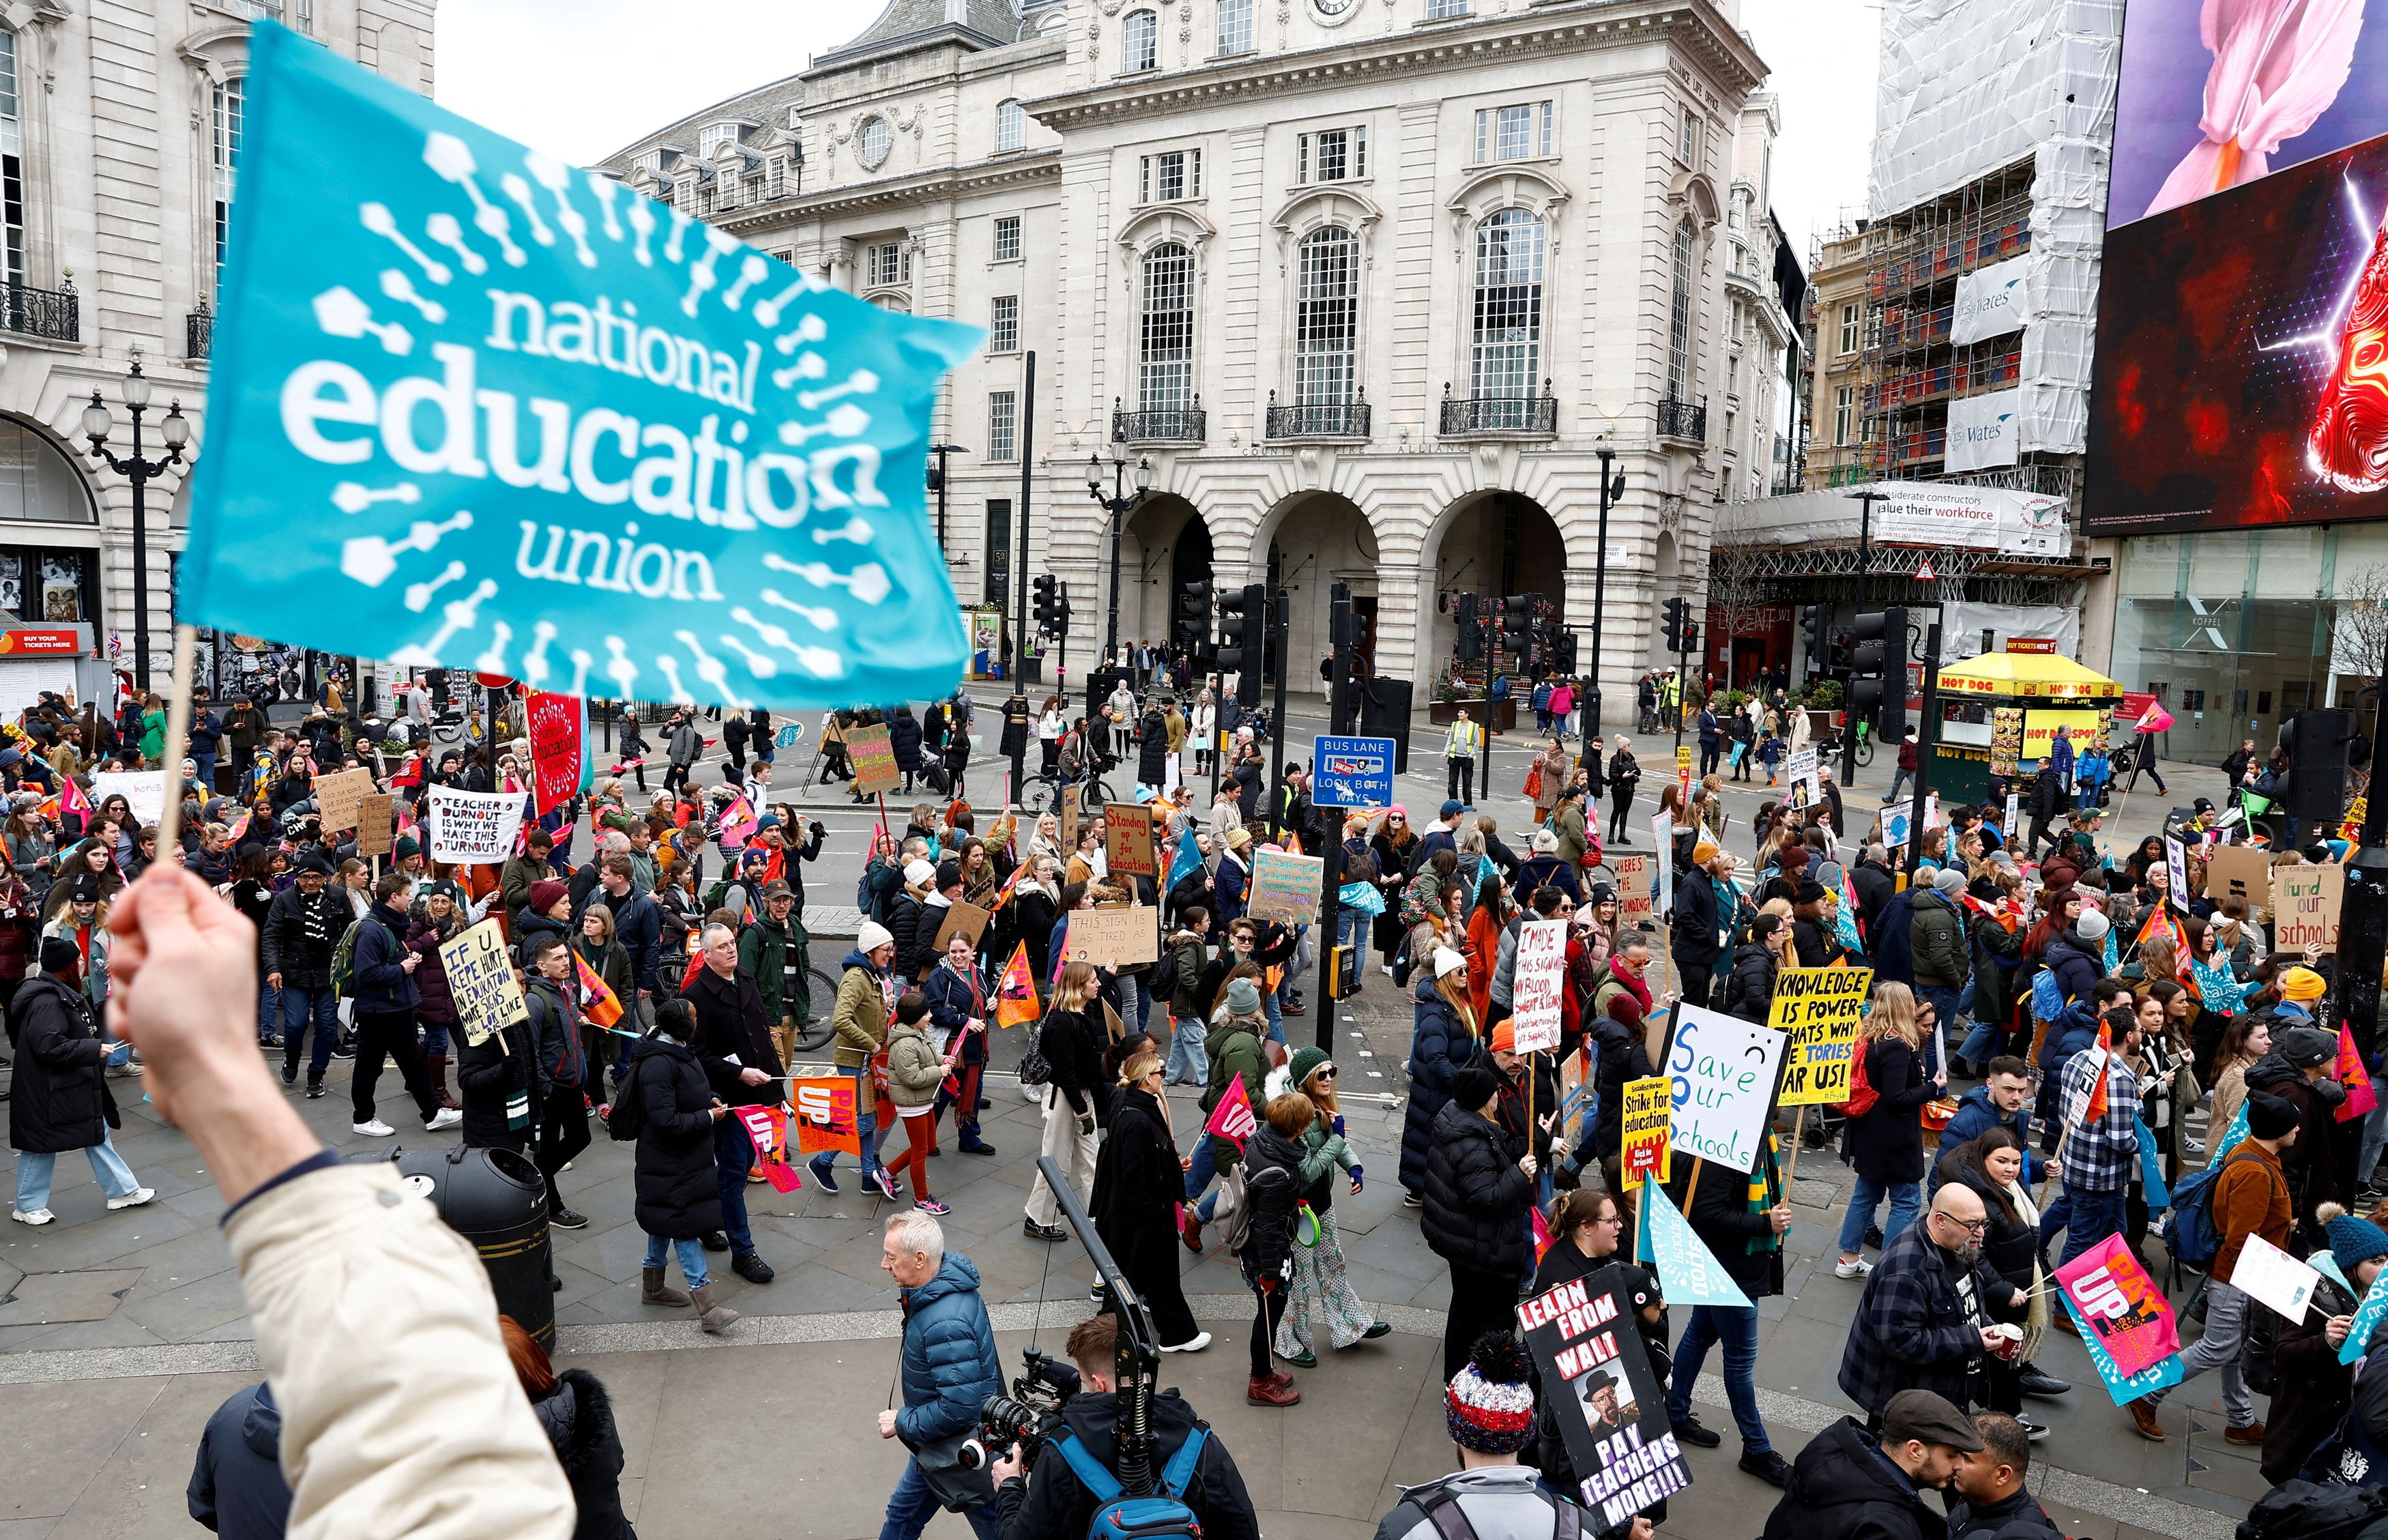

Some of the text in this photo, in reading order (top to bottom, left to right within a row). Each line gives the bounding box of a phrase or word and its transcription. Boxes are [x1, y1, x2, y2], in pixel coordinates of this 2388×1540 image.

[1977, 291, 2009, 314] Wates
[485, 289, 762, 413] national
[280, 341, 890, 530] education
[1967, 425, 2000, 442] Wates
[1242, 447, 1296, 456] COUNTY
[1398, 444, 1474, 452] ALLIANCE
[1517, 443, 1552, 451] LIFE
[1927, 494, 1981, 505] constructors
[1906, 504, 1993, 520] their workforce
[516, 520, 724, 602] union
[995, 552, 1005, 562] 52
[1779, 609, 1790, 622] W1
[2192, 618, 2222, 626] KOPPEL
[1942, 678, 1994, 692] HOT DOG
[2050, 684, 2091, 695] HOT DOG
[2026, 729, 2047, 739] HOT
[1324, 741, 1384, 753] BUS LANE
[1936, 747, 1990, 762] HOT DOG
[854, 754, 894, 768] Education
[1319, 779, 1351, 788] LOOK
[1356, 780, 1387, 790] BOTH
[443, 798, 501, 811] TEACHER
[1066, 794, 1075, 807] Invest
[1336, 793, 1369, 802] WAYS
[442, 808, 501, 822] BURNOUT
[1106, 809, 1146, 837] Standing
[442, 819, 499, 830] IS WHY WE
[442, 829, 497, 841] HAVE THIS
[1121, 831, 1130, 843] up
[443, 840, 499, 854] TURNOUT!
[1119, 843, 1133, 856] for
[1109, 856, 1151, 872] education
[1257, 854, 1296, 869] I teach
[1614, 857, 1642, 874] WHERE'S
[1261, 869, 1268, 877] to
[1271, 870, 1290, 881] stand
[1616, 877, 1631, 892] THE
[2284, 875, 2321, 897] Fund
[1263, 890, 1312, 905] MY TURN!
[1618, 897, 1650, 914] FUNDING?
[2297, 896, 2326, 913] our
[1072, 914, 1145, 929] THIS SIGN IS
[2280, 914, 2339, 945] schools
[1079, 929, 1145, 944] AS TIRED AS
[1519, 927, 1555, 953] I MADE
[446, 930, 492, 973] IF U
[1100, 946, 1125, 955] I AM
[449, 948, 506, 993] KEPE HURT-
[1517, 955, 1553, 973] THIS SIGN
[577, 961, 611, 1002] PAY
[1515, 977, 1552, 1000] MY BLOOD,
[1777, 972, 1868, 997] KNOWLEDGE
[455, 968, 511, 1013] IN EDUKATON
[461, 988, 505, 1028] MORE SIGNS
[1515, 993, 1545, 1014] SWEAT &
[1781, 998, 1862, 1024] IS POWER-
[466, 996, 522, 1038] WIL LOK LIKE
[1530, 1017, 1539, 1027] have
[1539, 1018, 1552, 1030] money
[1517, 1032, 1526, 1045] art
[1774, 1021, 1856, 1045] THAT'S WHY
[1672, 1022, 1756, 1092] Save
[1805, 1043, 1852, 1063] TORIES
[1815, 1064, 1846, 1090] US!
[1631, 1084, 1648, 1093] Socialist
[1671, 1075, 1734, 1109] Our
[1625, 1091, 1669, 1114] Strike for
[1824, 1092, 1846, 1103] #PayUp
[830, 1090, 856, 1137] PAY
[1625, 1111, 1668, 1133] education
[766, 1109, 785, 1163] PAY
[1633, 1157, 1646, 1167] Tories
[1634, 1149, 1645, 1159] Kick
[2106, 1252, 2167, 1318] PAY
[1517, 1278, 1588, 1331] LEARN
[1556, 1292, 1619, 1341] FROM
[1554, 1331, 1620, 1380] WALT
[1595, 1423, 1644, 1468] PAY
[1579, 1432, 1682, 1507] TEACHERS
[1601, 1462, 1688, 1528] MORE!!!
